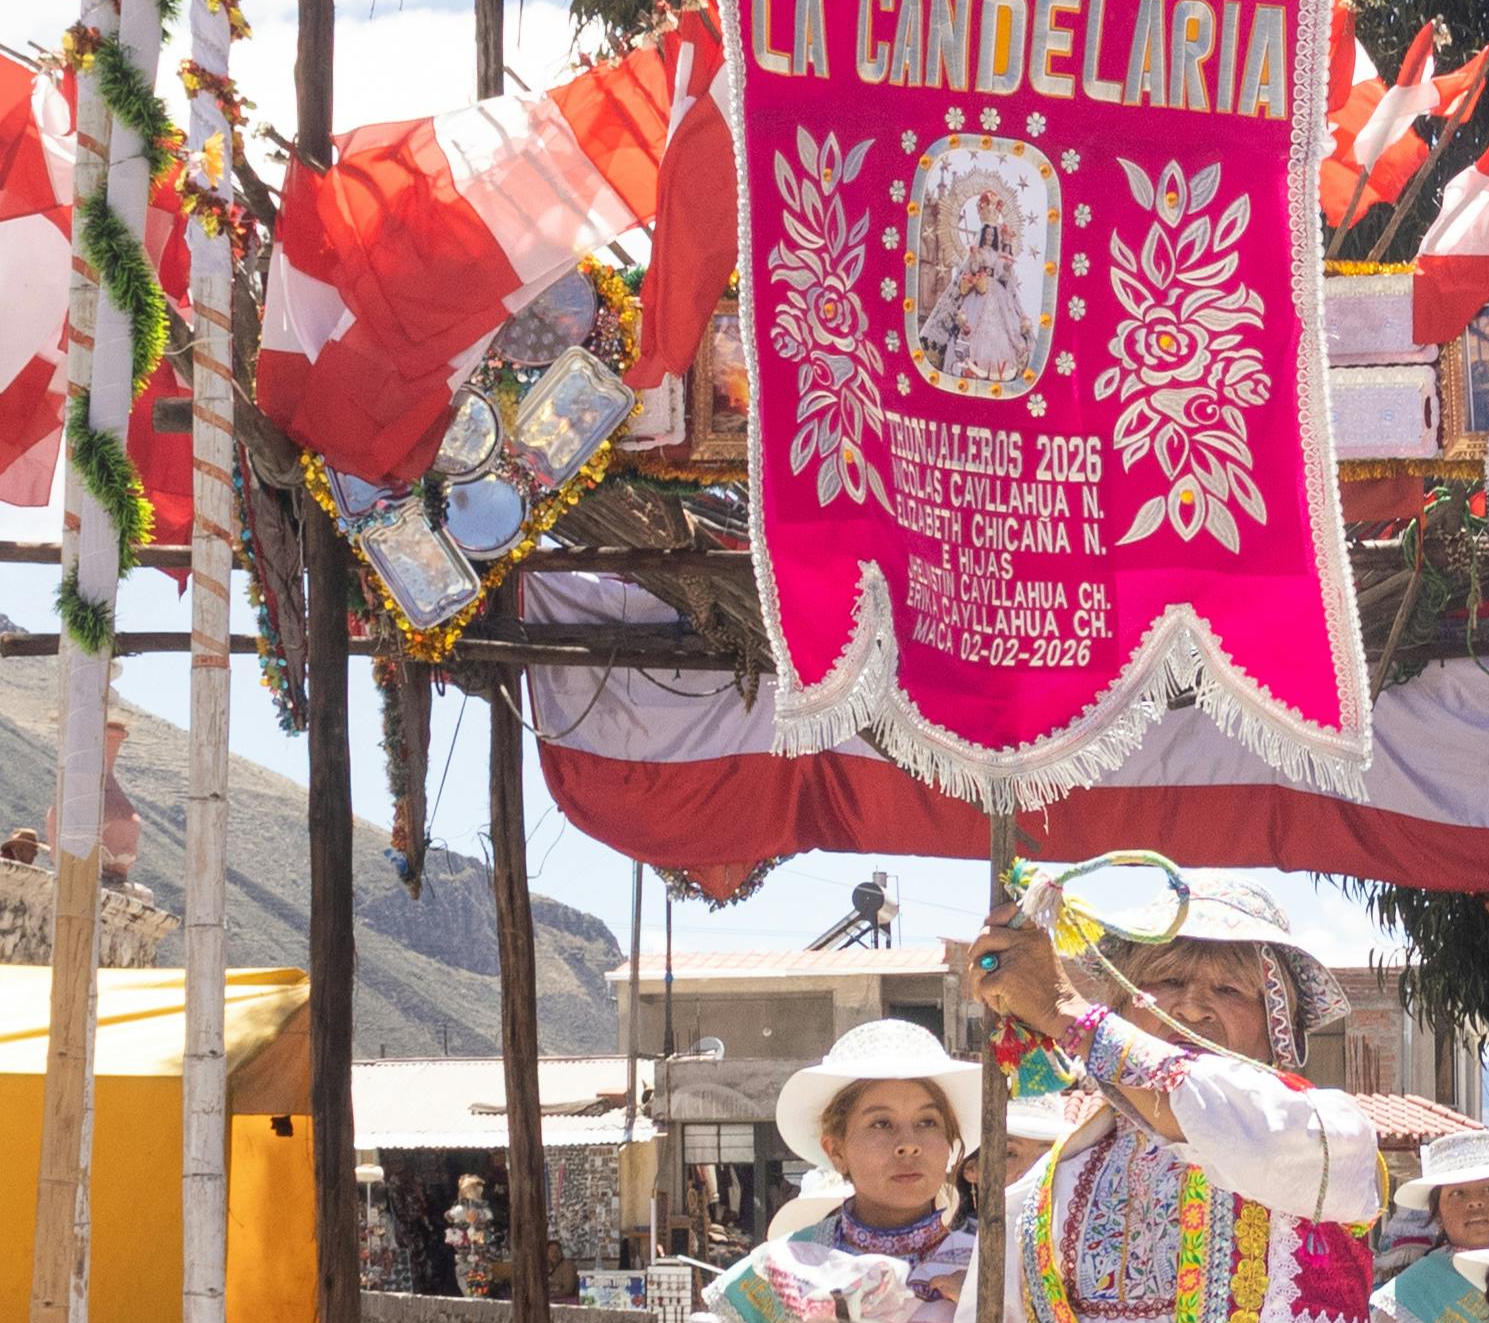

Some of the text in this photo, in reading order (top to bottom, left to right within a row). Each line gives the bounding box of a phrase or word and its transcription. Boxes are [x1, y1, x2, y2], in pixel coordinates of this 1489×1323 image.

[1037, 434, 1102, 482] 2026
[950, 472, 1070, 518] CAYLLAHUA
[1082, 486, 1104, 519] N.
[971, 513, 1071, 554] CHICAÑA
[1084, 523, 1106, 555] N.
[942, 543, 1013, 580] E HIJAS
[906, 580, 1112, 638] ERIKA CAYLLAHUA CH.
[960, 574, 1068, 609] CAYLLAHUA
[1078, 582, 1112, 610] CH.
[913, 614, 1092, 667] MACA 02-02-2026
